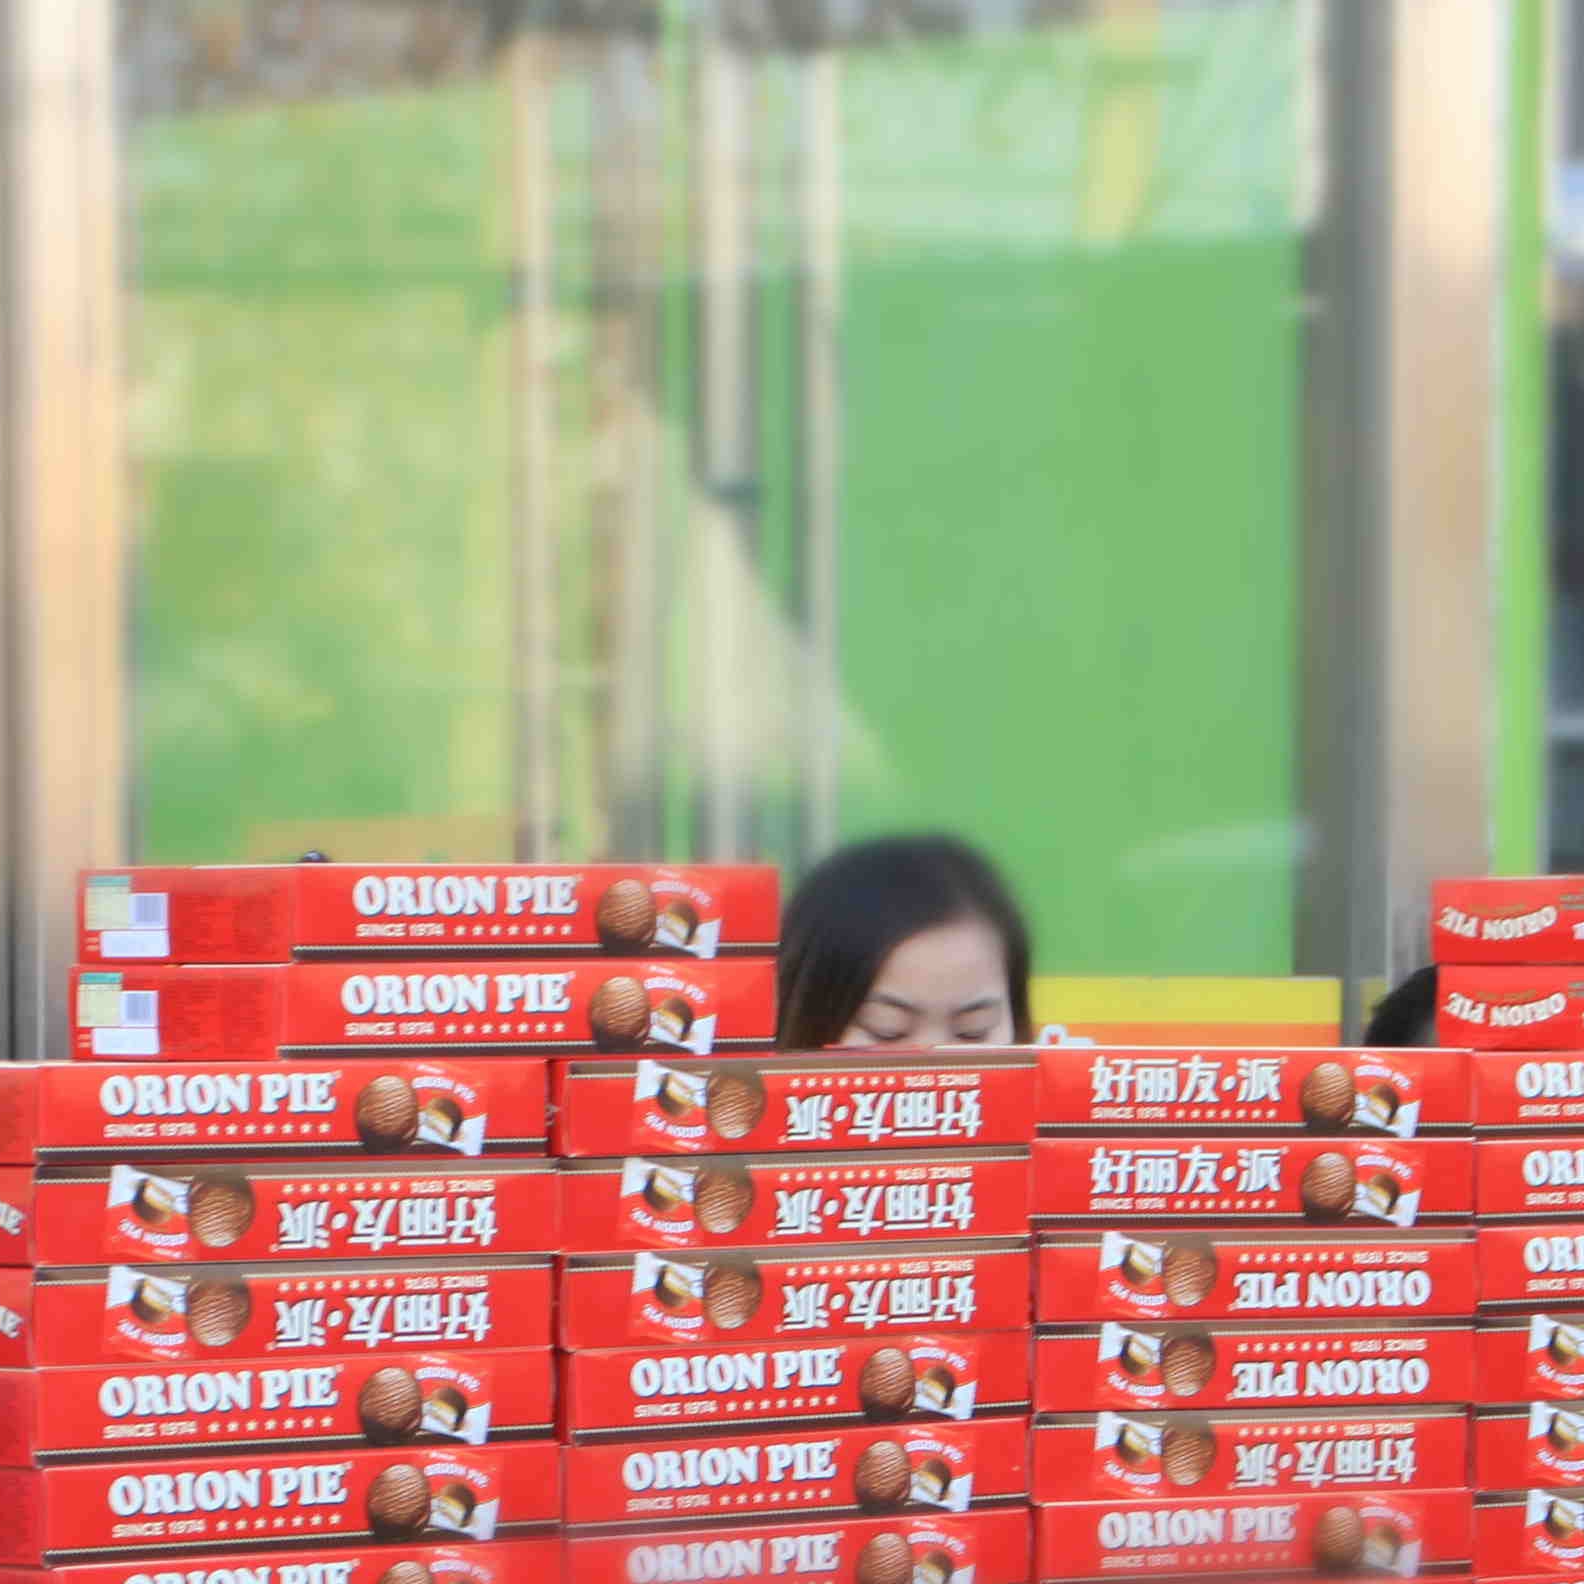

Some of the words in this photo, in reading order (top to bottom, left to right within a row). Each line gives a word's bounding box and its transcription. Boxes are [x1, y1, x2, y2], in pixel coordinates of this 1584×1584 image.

[353, 875, 499, 916] ORION
[503, 874, 582, 915] PIE
[356, 923, 406, 937] SINCE
[341, 973, 489, 1015] ORION
[493, 971, 573, 1013] PIE
[344, 1021, 396, 1036] SINCE
[99, 1073, 252, 1116] ORION
[258, 1070, 338, 1113] PIE
[103, 1123, 156, 1138] SINCE
[1231, 1272, 1301, 1311] PIE
[1305, 1270, 1431, 1308] ORION
[630, 1351, 767, 1397] ORION
[771, 1348, 844, 1389] PIE
[1231, 1361, 1299, 1400] PIE
[1303, 1357, 1430, 1397] ORION
[99, 1370, 253, 1417] ORION
[258, 1370, 340, 1409] PIE
[103, 1422, 157, 1439] SINCE
[622, 1445, 760, 1491] ORION
[764, 1439, 839, 1482] PIE
[108, 1468, 262, 1516] ORION
[267, 1463, 349, 1507] PIE
[626, 1496, 673, 1512] SINCE
[111, 1522, 165, 1539] SINCE
[1098, 1508, 1225, 1549] ORION
[1230, 1505, 1295, 1543] PIE
[628, 1538, 764, 1584] ORION
[769, 1532, 841, 1574] PIE
